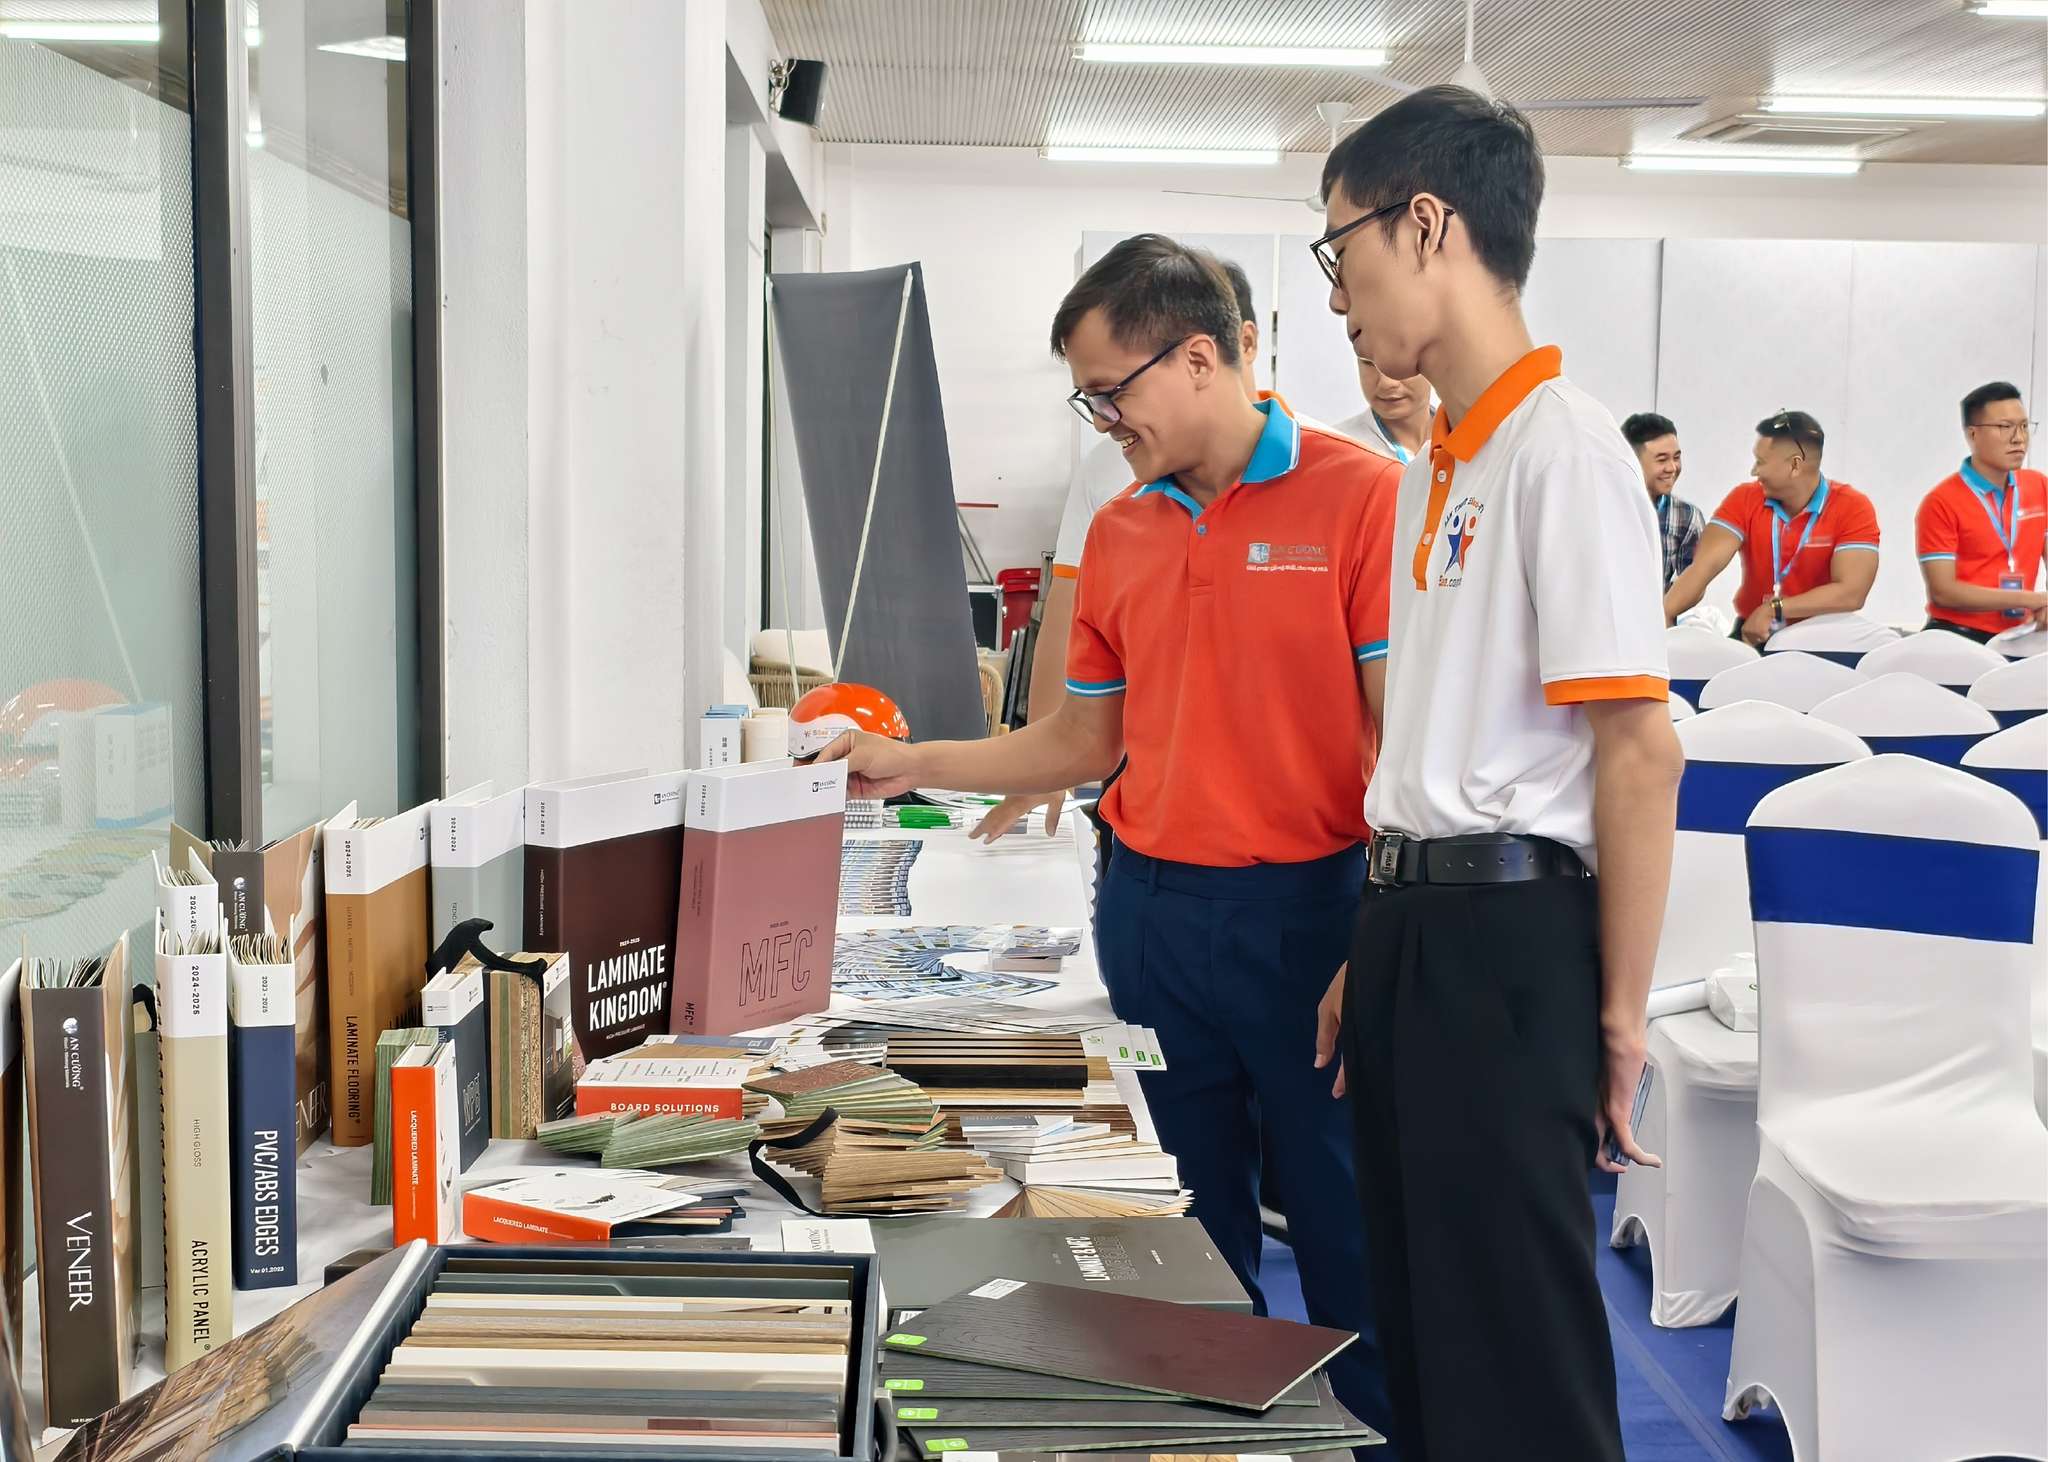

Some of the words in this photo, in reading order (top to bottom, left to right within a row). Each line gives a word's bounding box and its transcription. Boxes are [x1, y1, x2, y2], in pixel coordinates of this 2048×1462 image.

[238, 890, 246, 902] AN
[587, 943, 666, 993] LAMINATE
[739, 928, 813, 1007] MFC
[589, 982, 663, 1032] KINGDOM
[69, 1036, 80, 1051] AN
[346, 1016, 358, 1065] LAMINATE
[71, 1051, 82, 1088] CƯỜNG
[347, 1069, 361, 1119] FLOORING
[296, 1081, 328, 1142] NEER
[410, 1110, 418, 1150] LACQUERED
[610, 1103, 650, 1112] BOARD
[654, 1103, 720, 1113] SOLUTIONS
[194, 1141, 202, 1168] GLOSS
[254, 1130, 279, 1202] PVC/ABS
[411, 1152, 419, 1185] LAMINATE
[254, 1206, 279, 1256] EDGES
[66, 1211, 93, 1312] VENEER
[191, 1240, 209, 1296] ACRYLIC
